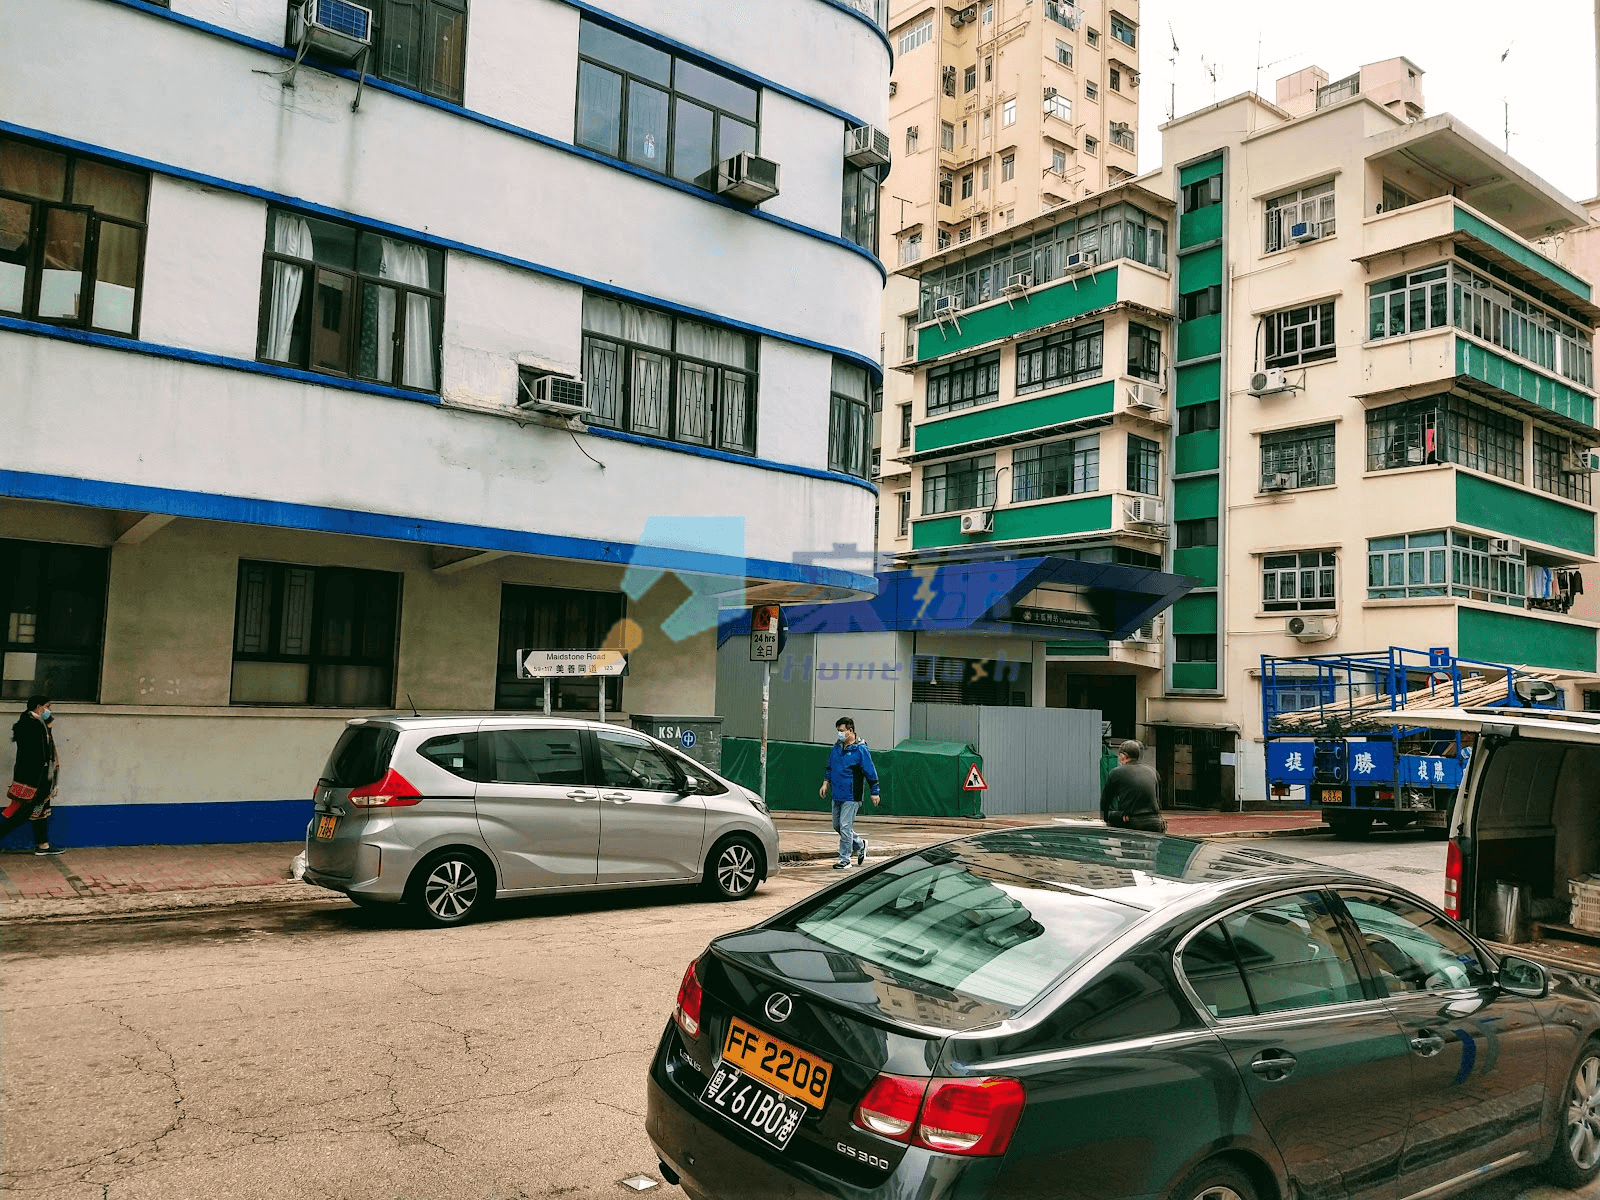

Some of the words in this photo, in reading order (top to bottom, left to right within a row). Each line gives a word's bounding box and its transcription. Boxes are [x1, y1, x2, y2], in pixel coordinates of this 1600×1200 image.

[754, 634, 763, 643] 24
[764, 634, 776, 643] hrs
[756, 645, 773, 657] 全日
[555, 664, 598, 674] 美善同道
[658, 726, 682, 739] KSA
[726, 1024, 760, 1060] FF
[759, 1041, 828, 1099] 2208
[857, 1150, 889, 1170] 300
